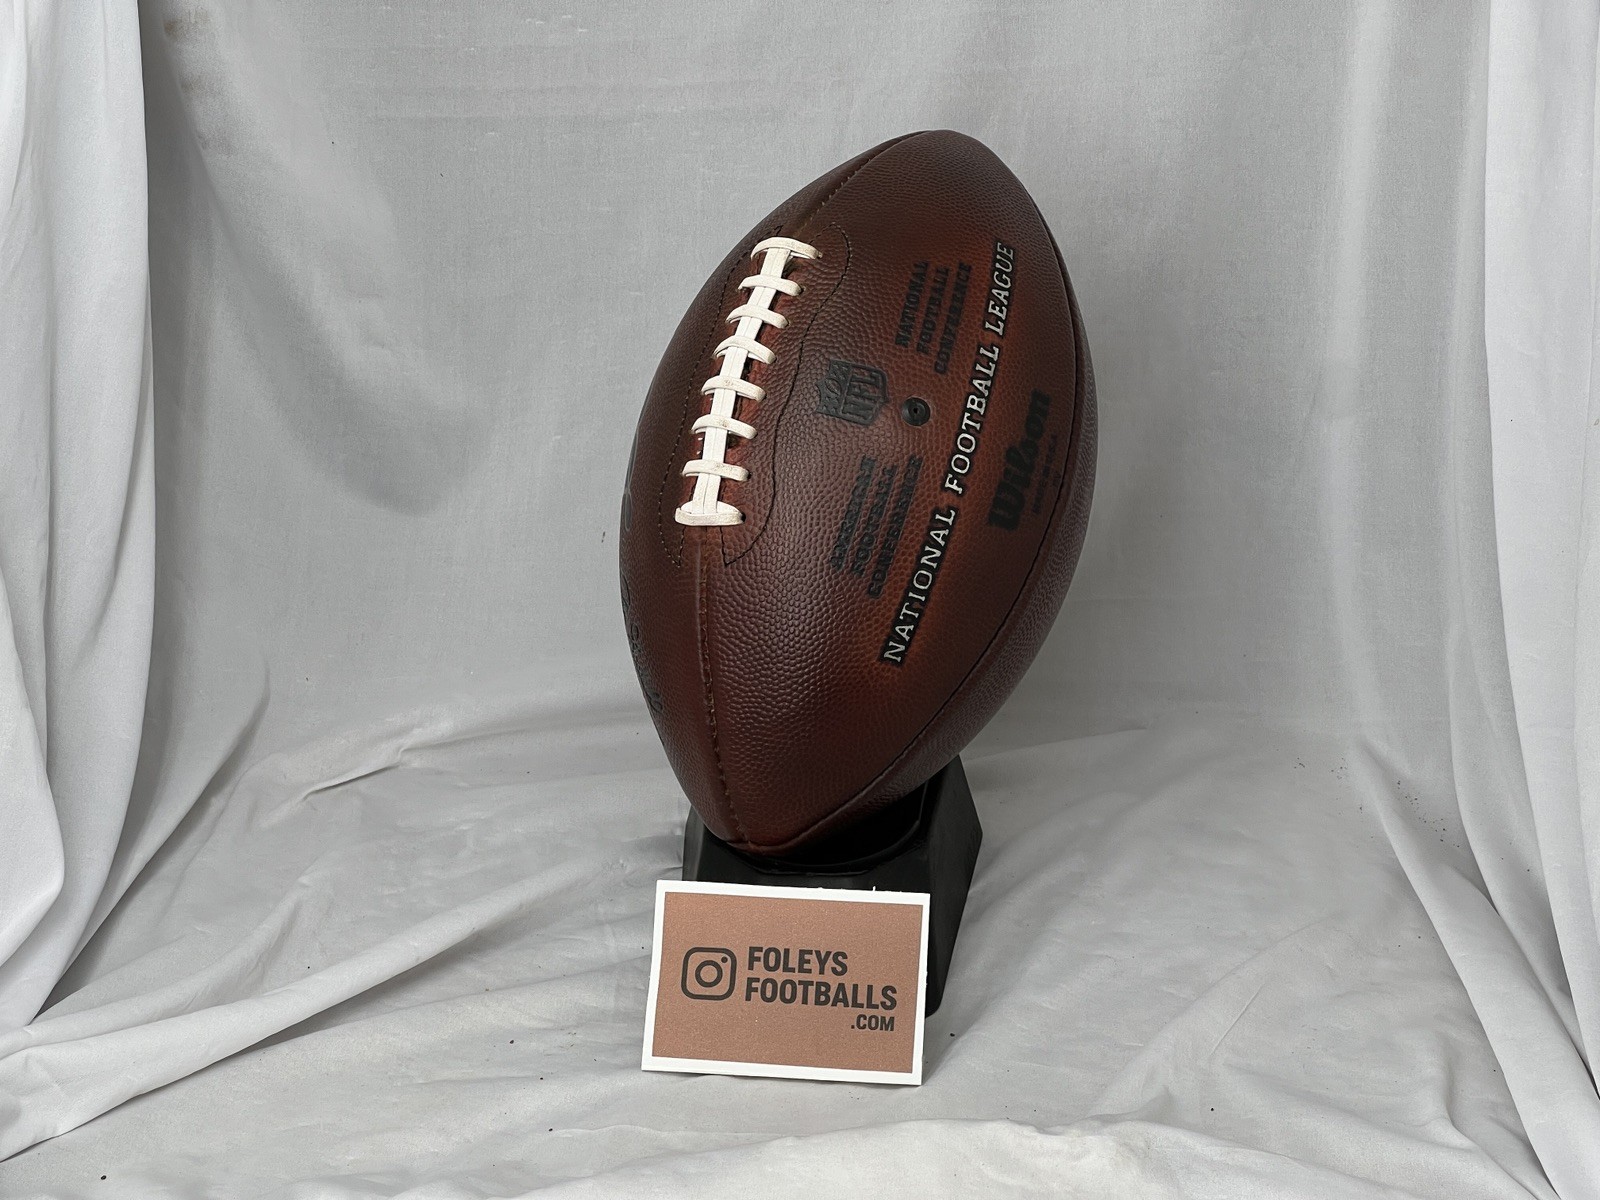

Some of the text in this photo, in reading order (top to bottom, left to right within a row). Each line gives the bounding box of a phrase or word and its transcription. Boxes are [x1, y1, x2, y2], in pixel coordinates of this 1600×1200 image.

[895, 260, 929, 347] NATIONAL
[917, 265, 950, 354] FOOTBALL
[934, 261, 972, 375] CONFERENCE
[884, 242, 1014, 663] NATIONAL FOOTBALL LEAGUE
[988, 388, 1051, 531] Wilson
[829, 454, 877, 571] AMERICAN
[851, 463, 898, 577] FOOTBALL
[867, 454, 923, 598] CONFERENCE
[745, 977, 897, 1011] FOOTBALLS
[747, 946, 848, 976] FOLEYS
[850, 1014, 895, 1031] .COM
